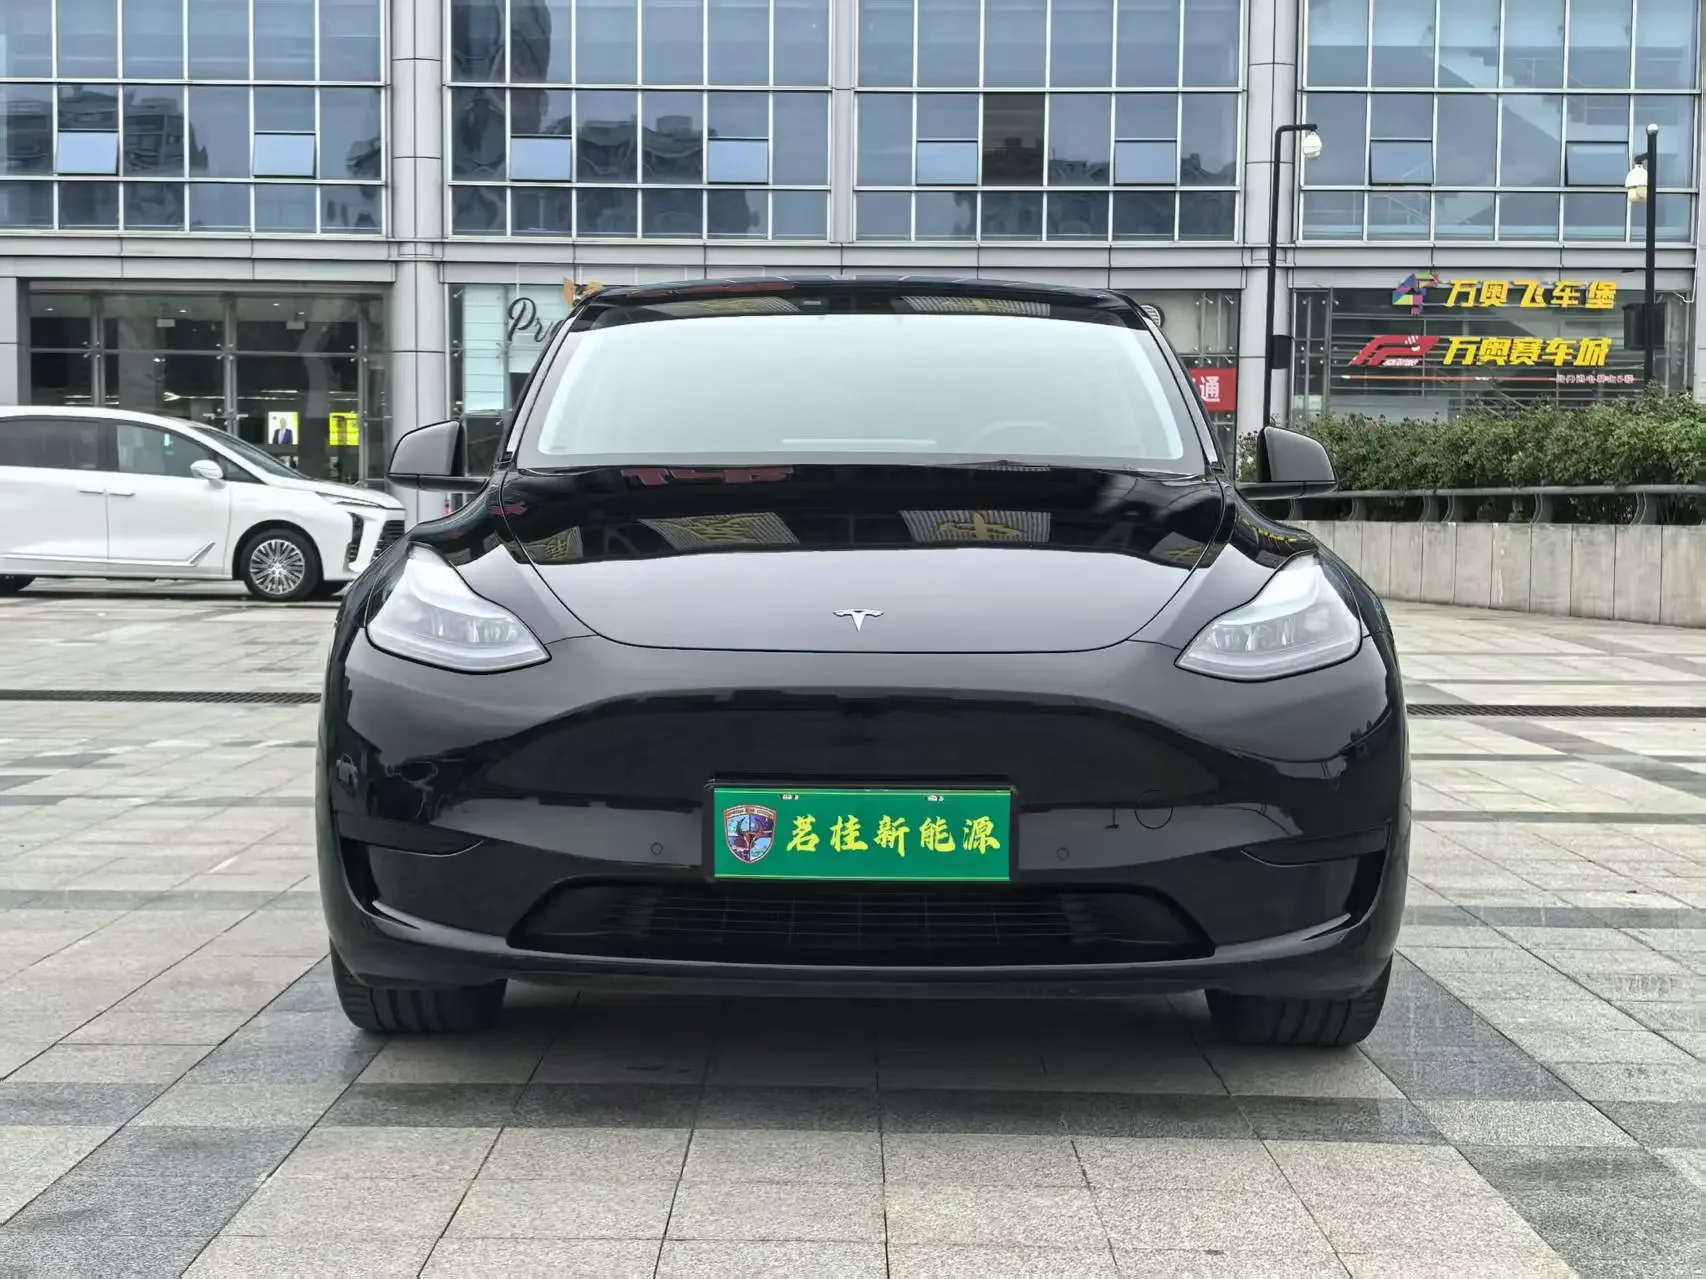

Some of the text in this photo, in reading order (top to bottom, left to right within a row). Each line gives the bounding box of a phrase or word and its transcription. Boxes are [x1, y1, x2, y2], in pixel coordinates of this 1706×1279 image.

[1445, 280, 1617, 309] 万奥飞车堡
[1443, 336, 1612, 367] 万奥赛车城
[1191, 375, 1220, 402] 通
